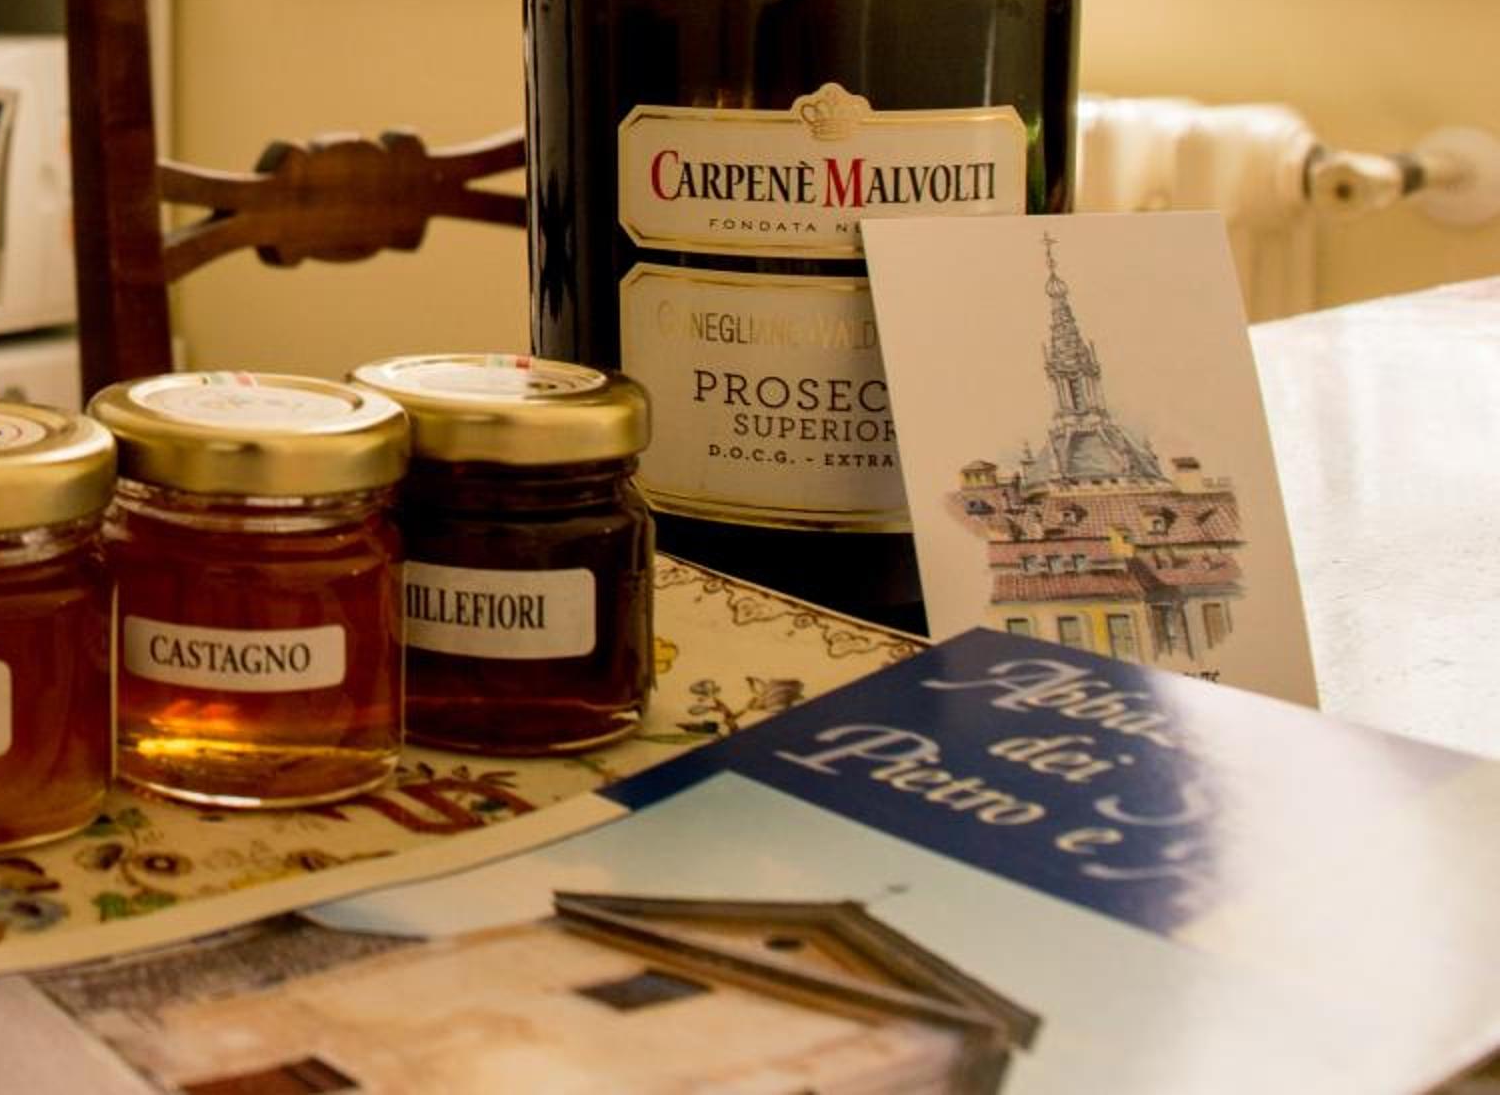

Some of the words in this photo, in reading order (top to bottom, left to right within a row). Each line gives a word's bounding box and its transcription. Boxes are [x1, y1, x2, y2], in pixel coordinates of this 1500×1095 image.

[651, 150, 818, 203] CARPENÈ
[822, 158, 996, 207] MALVOLTI
[709, 218, 817, 233] FONDATA
[693, 370, 887, 412] PROSEC
[709, 444, 795, 464] D.O.C.G.
[825, 454, 893, 468] EXTRA
[150, 634, 311, 674] CASTAGNO
[774, 724, 1046, 826] Pietro
[988, 734, 1135, 783] dei
